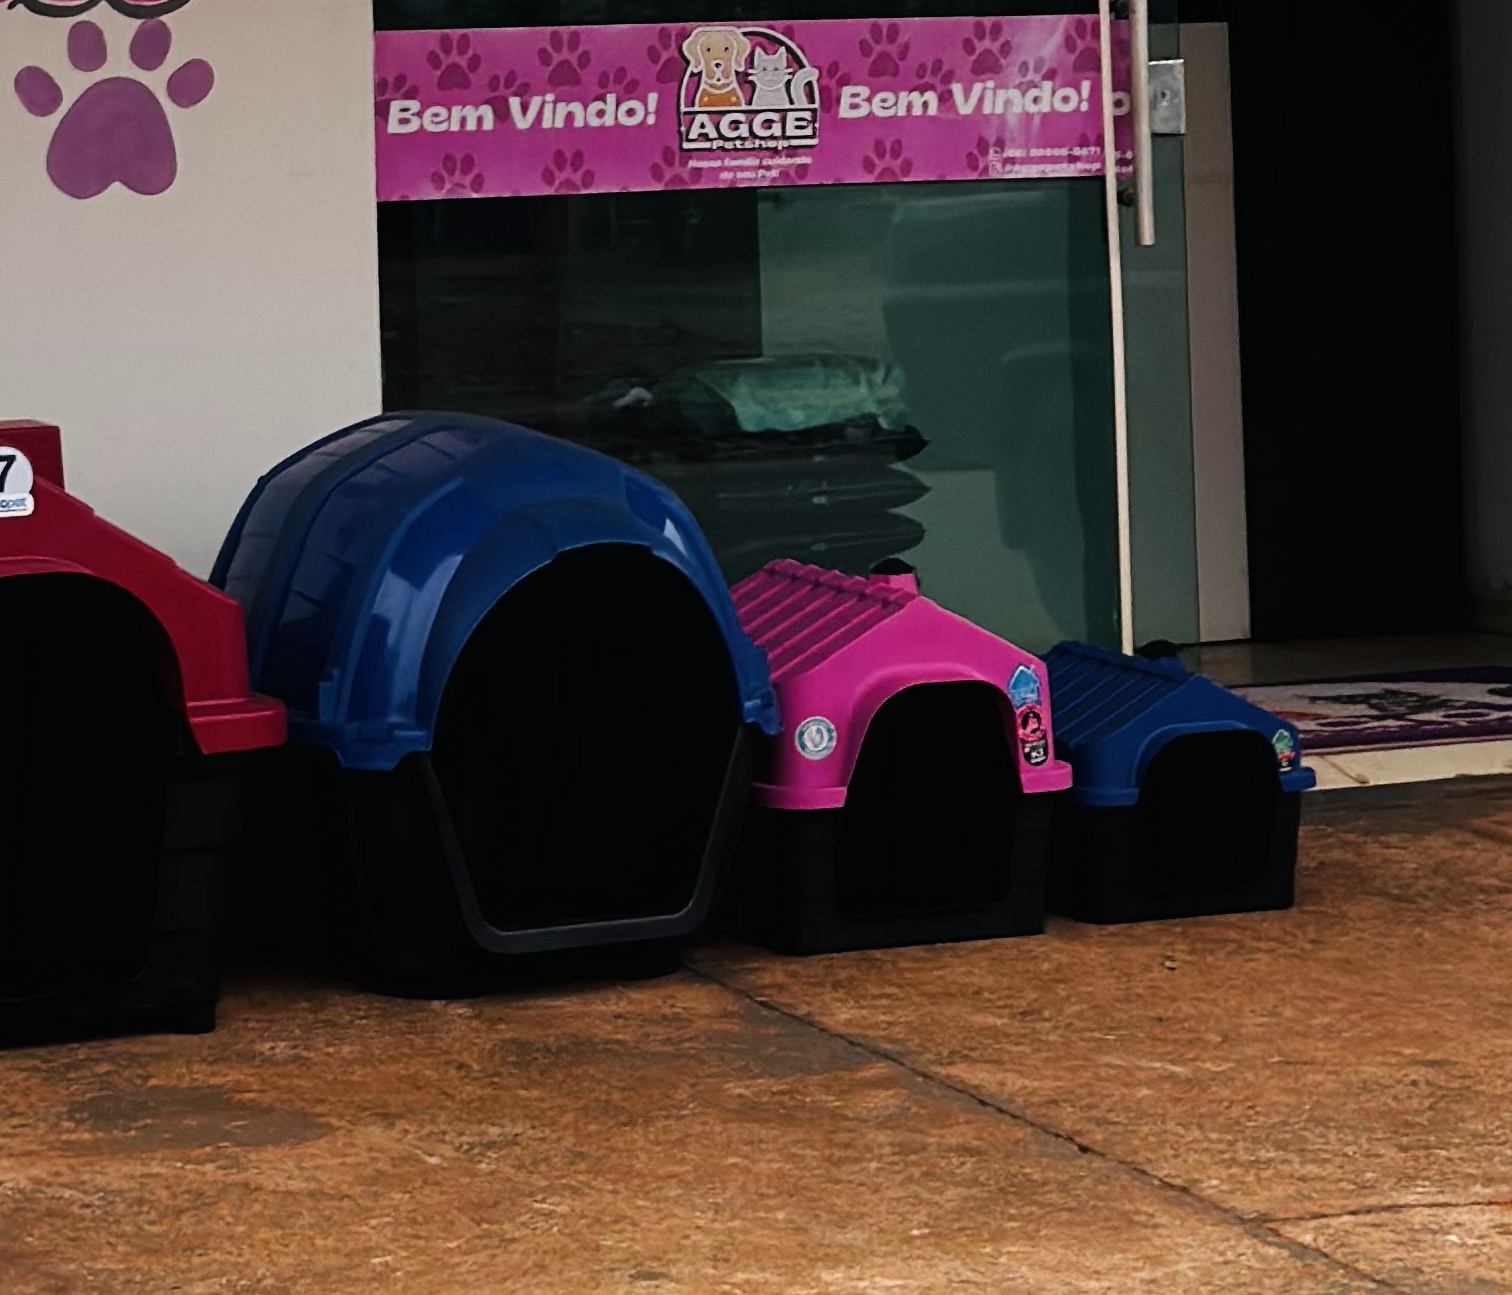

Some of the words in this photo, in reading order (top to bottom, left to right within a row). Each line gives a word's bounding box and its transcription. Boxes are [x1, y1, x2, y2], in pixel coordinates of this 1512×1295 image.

[386, 98, 494, 135] Bem
[508, 92, 659, 131] Vindo!
[838, 82, 942, 120] Bem
[951, 79, 1092, 115] Vindo!
[688, 111, 814, 140] AGGE
